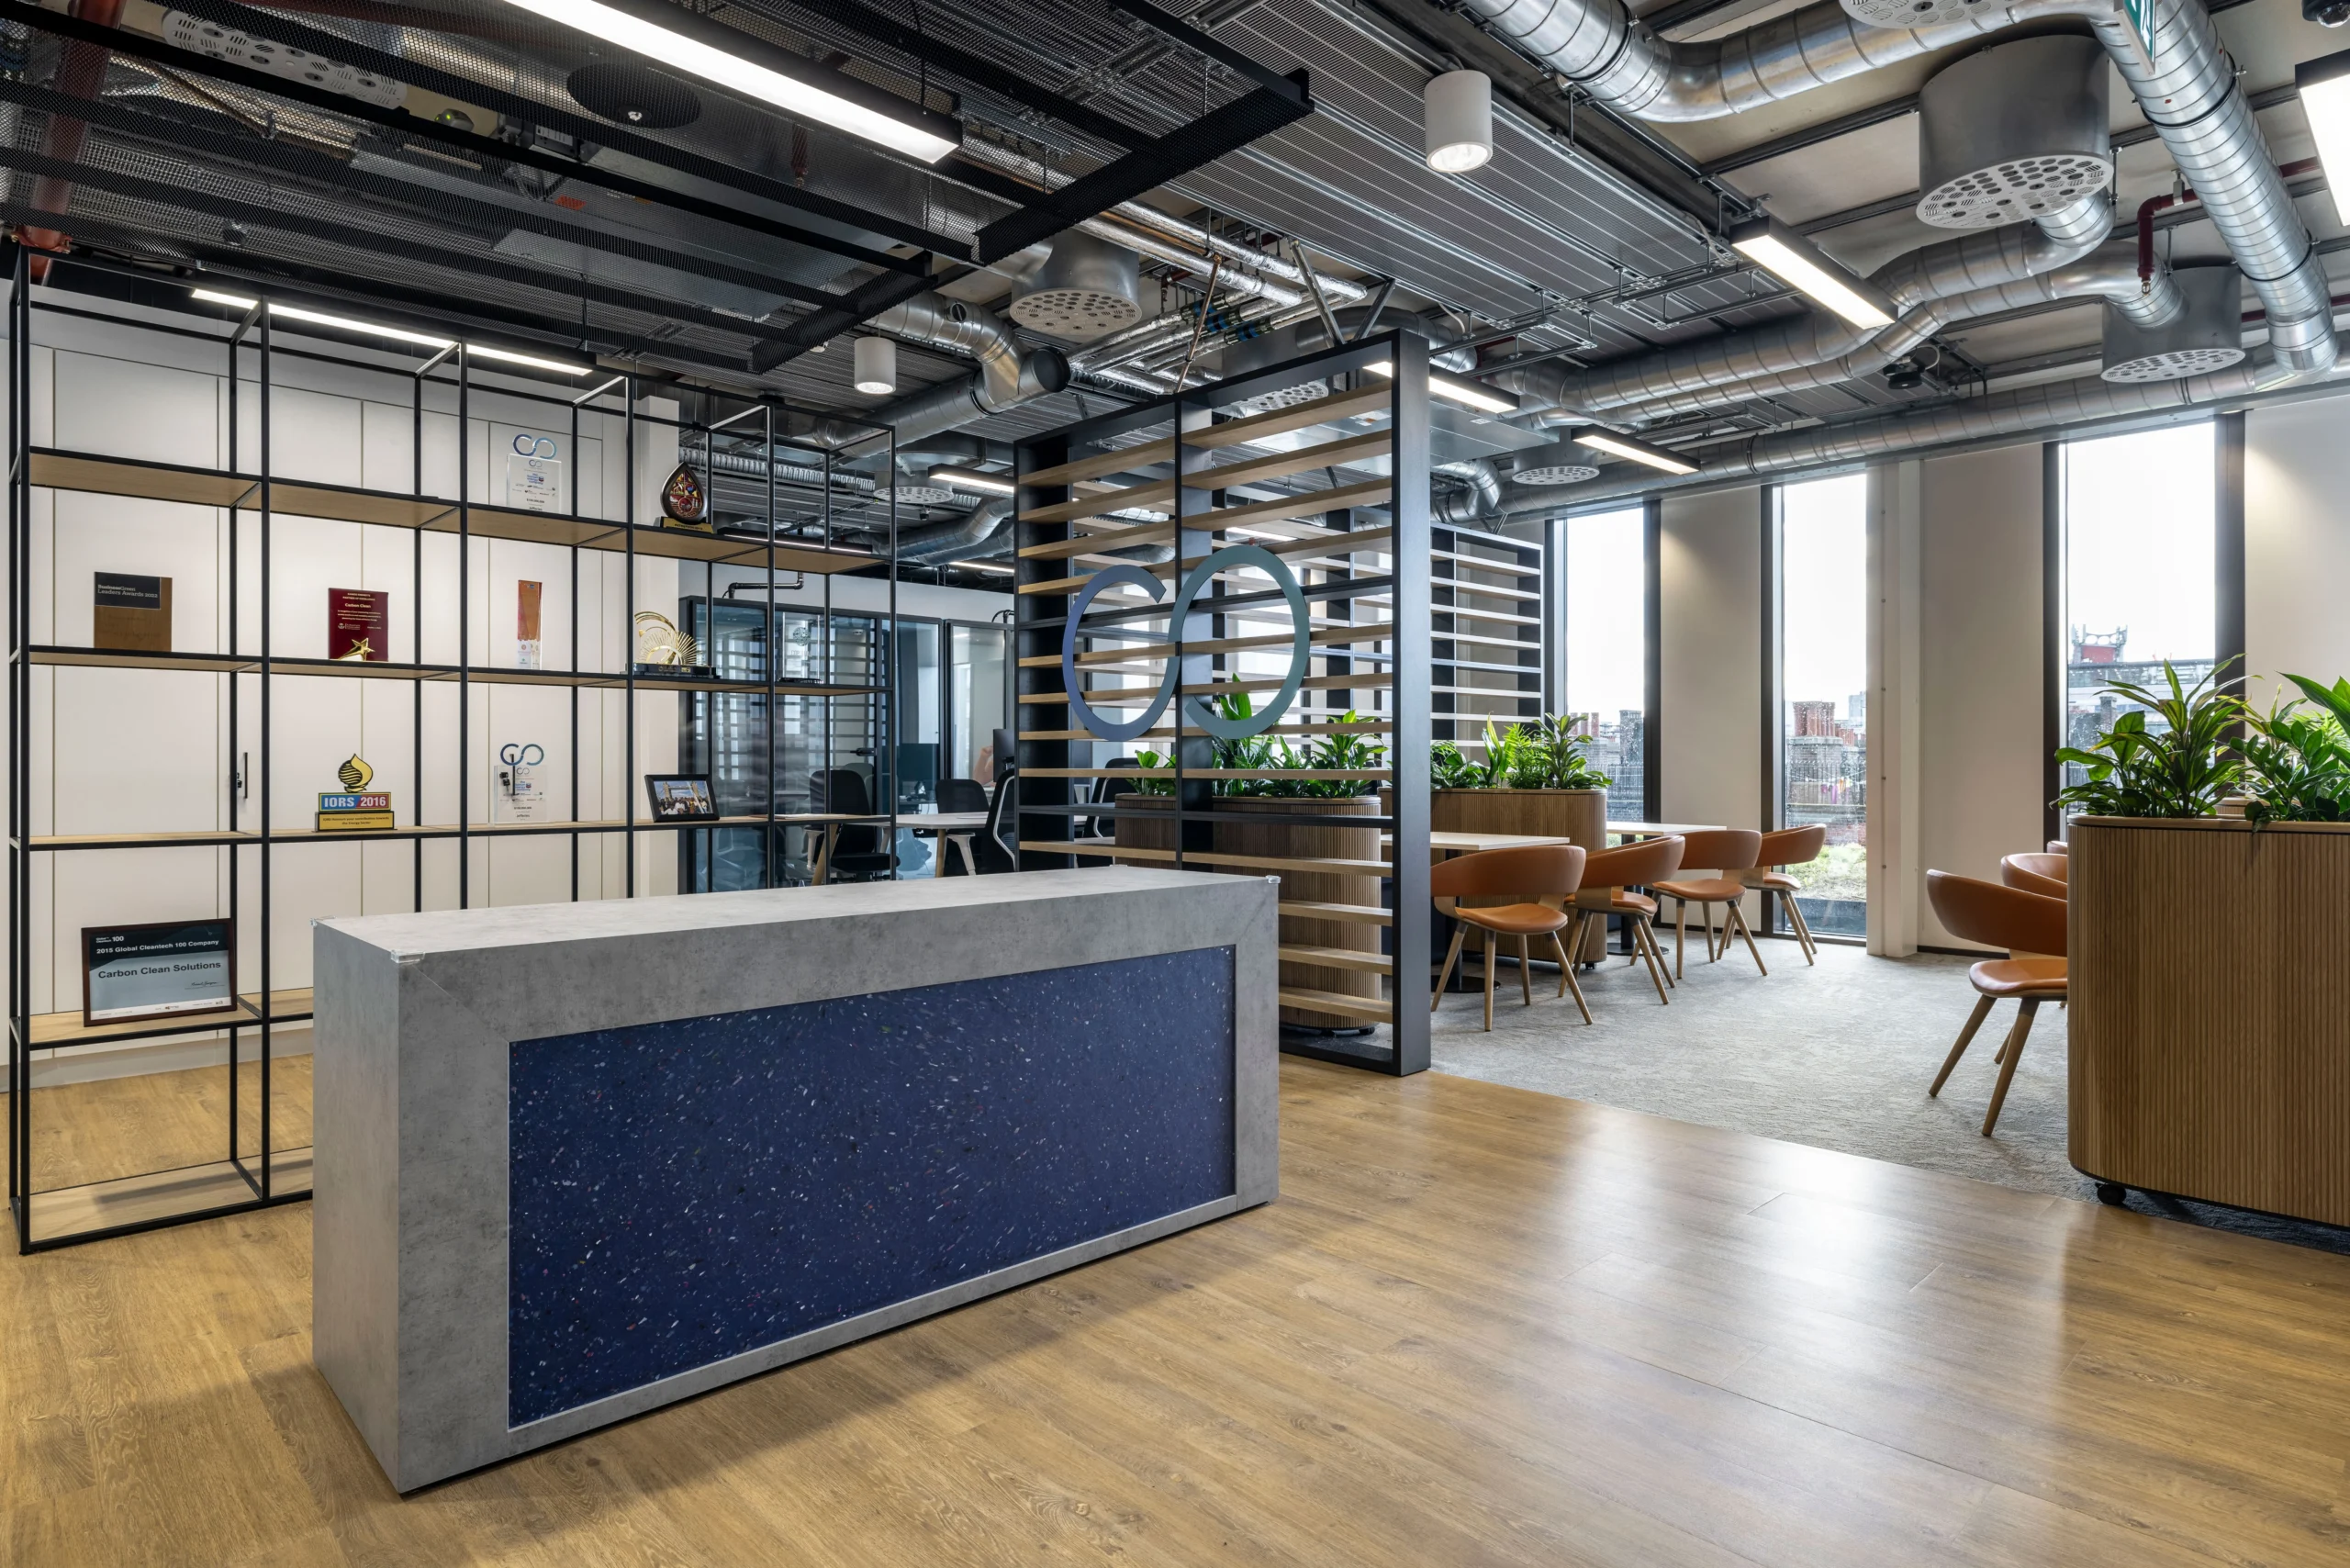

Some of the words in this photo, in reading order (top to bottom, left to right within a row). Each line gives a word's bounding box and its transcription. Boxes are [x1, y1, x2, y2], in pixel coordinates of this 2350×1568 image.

[324, 797, 355, 807] IORS
[360, 796, 386, 806] 2016
[98, 968, 137, 979] Carbon
[141, 965, 170, 975] Clean
[173, 961, 221, 972] Solutions
